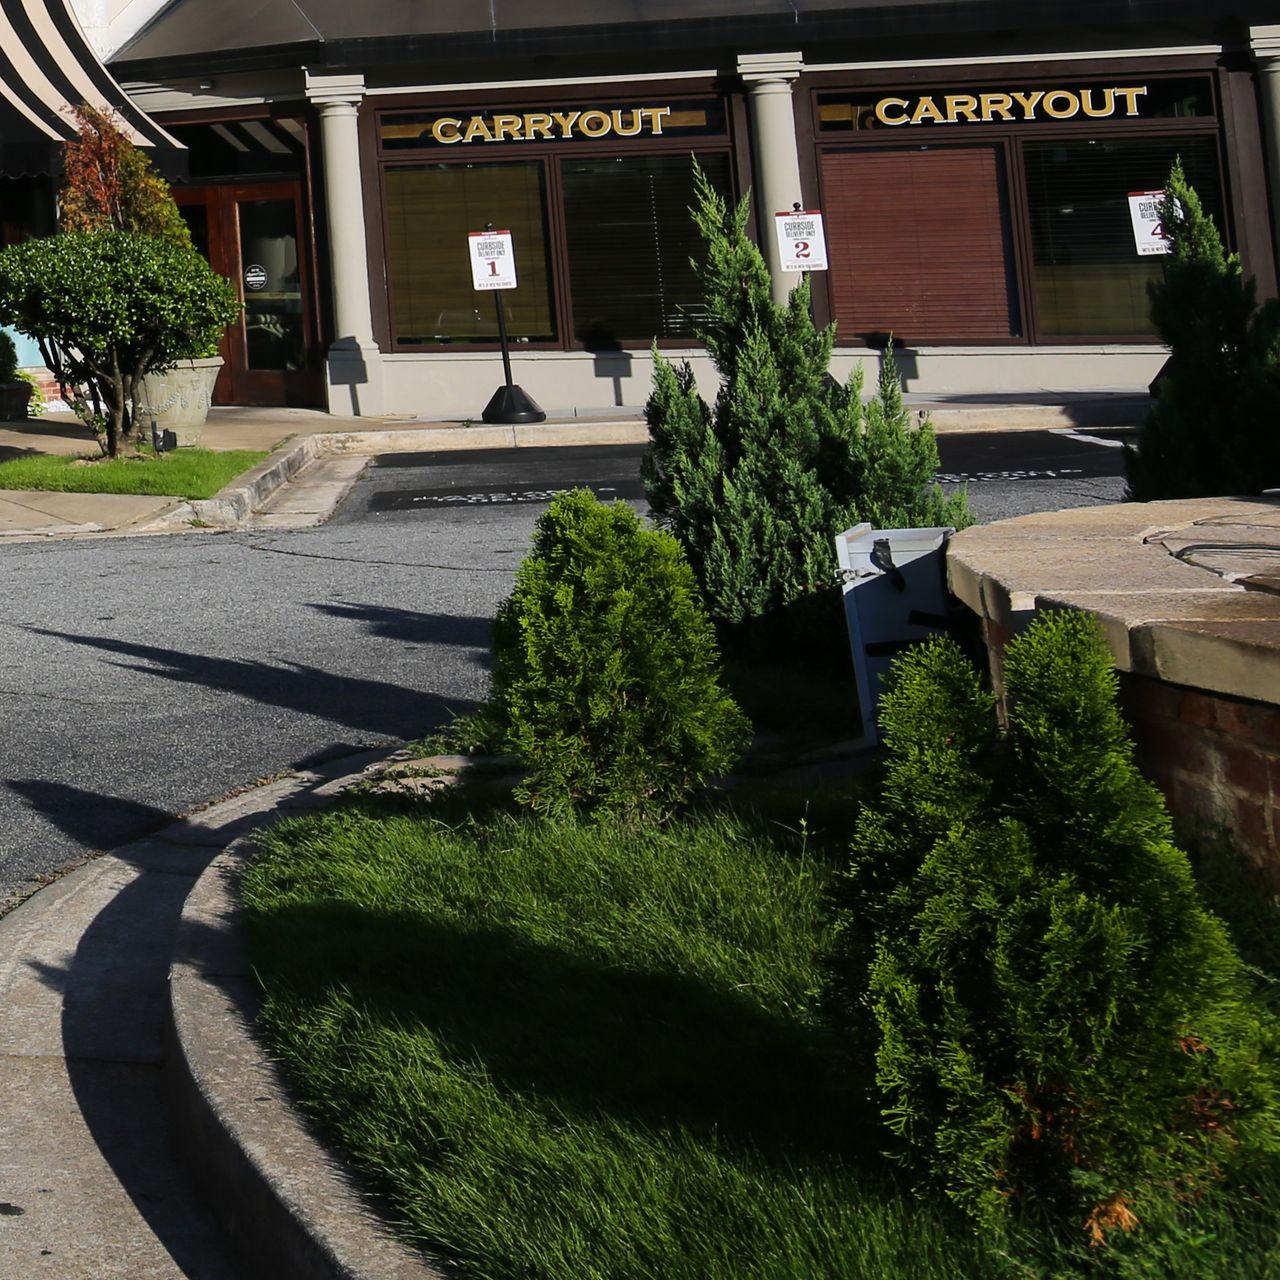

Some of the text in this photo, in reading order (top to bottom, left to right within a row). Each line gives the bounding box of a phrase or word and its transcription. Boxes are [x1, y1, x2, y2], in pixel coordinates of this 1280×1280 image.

[875, 86, 1147, 125] CARRYOUT
[432, 106, 670, 144] CARRYOUT
[784, 220, 815, 232] CURBSIDE
[476, 240, 505, 251] CURBSIDE
[794, 241, 811, 259] 2
[487, 260, 501, 277] 1
